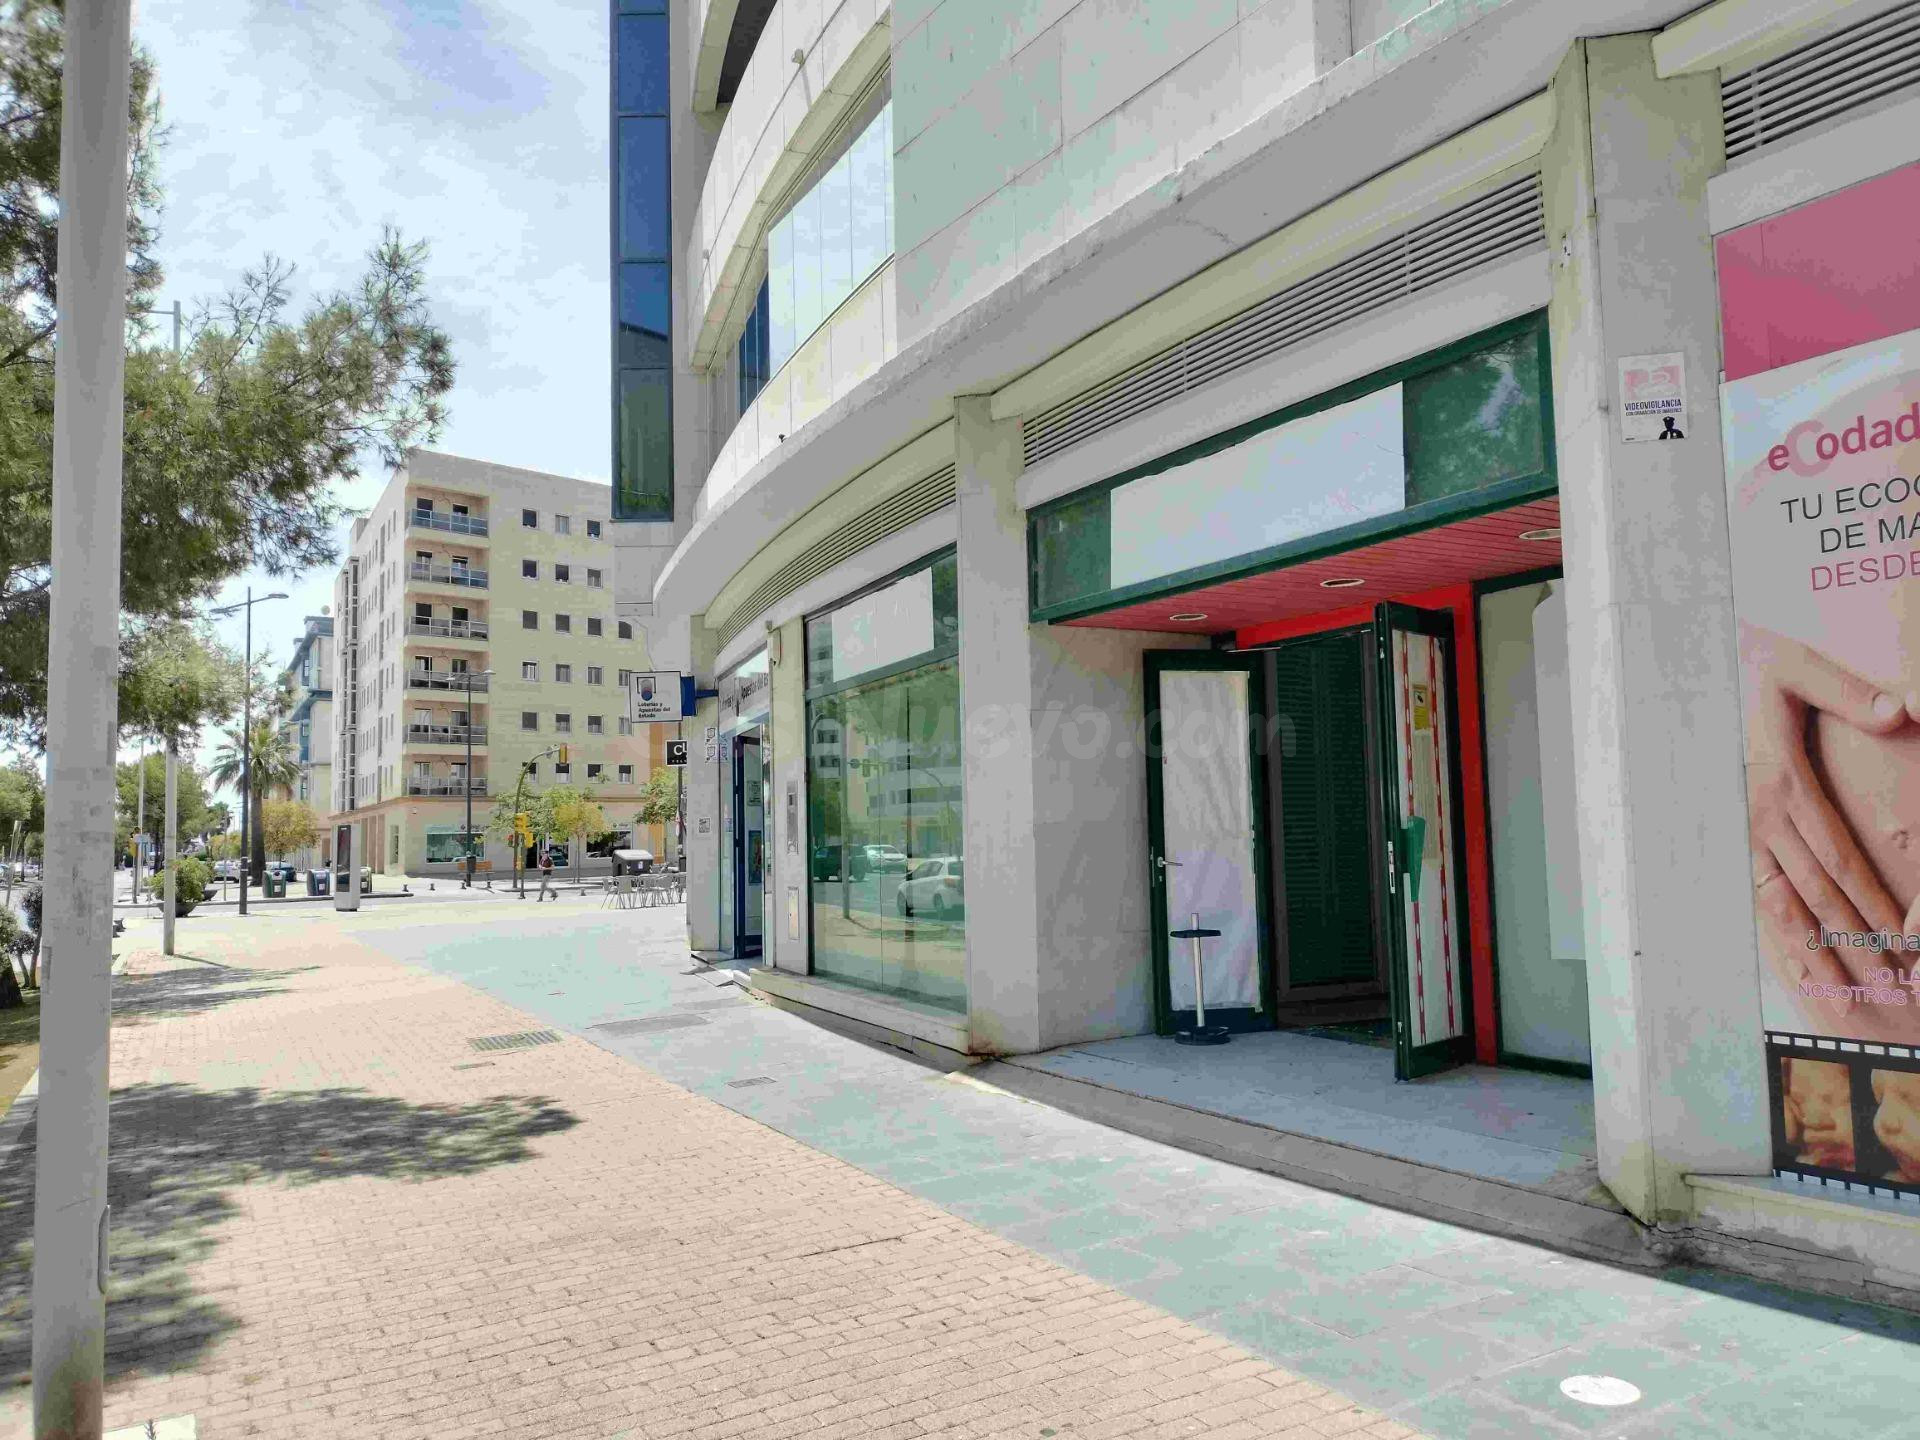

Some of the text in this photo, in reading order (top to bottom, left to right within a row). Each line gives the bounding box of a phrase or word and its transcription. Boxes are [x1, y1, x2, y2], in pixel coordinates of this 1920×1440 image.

[1624, 398, 1681, 411] VIDEOVIGILANCIA
[1780, 493, 1822, 523] TU
[1820, 522, 1866, 553] DE
[1863, 966, 1894, 984] NO
[1797, 982, 1908, 1007] NOSOTROS
